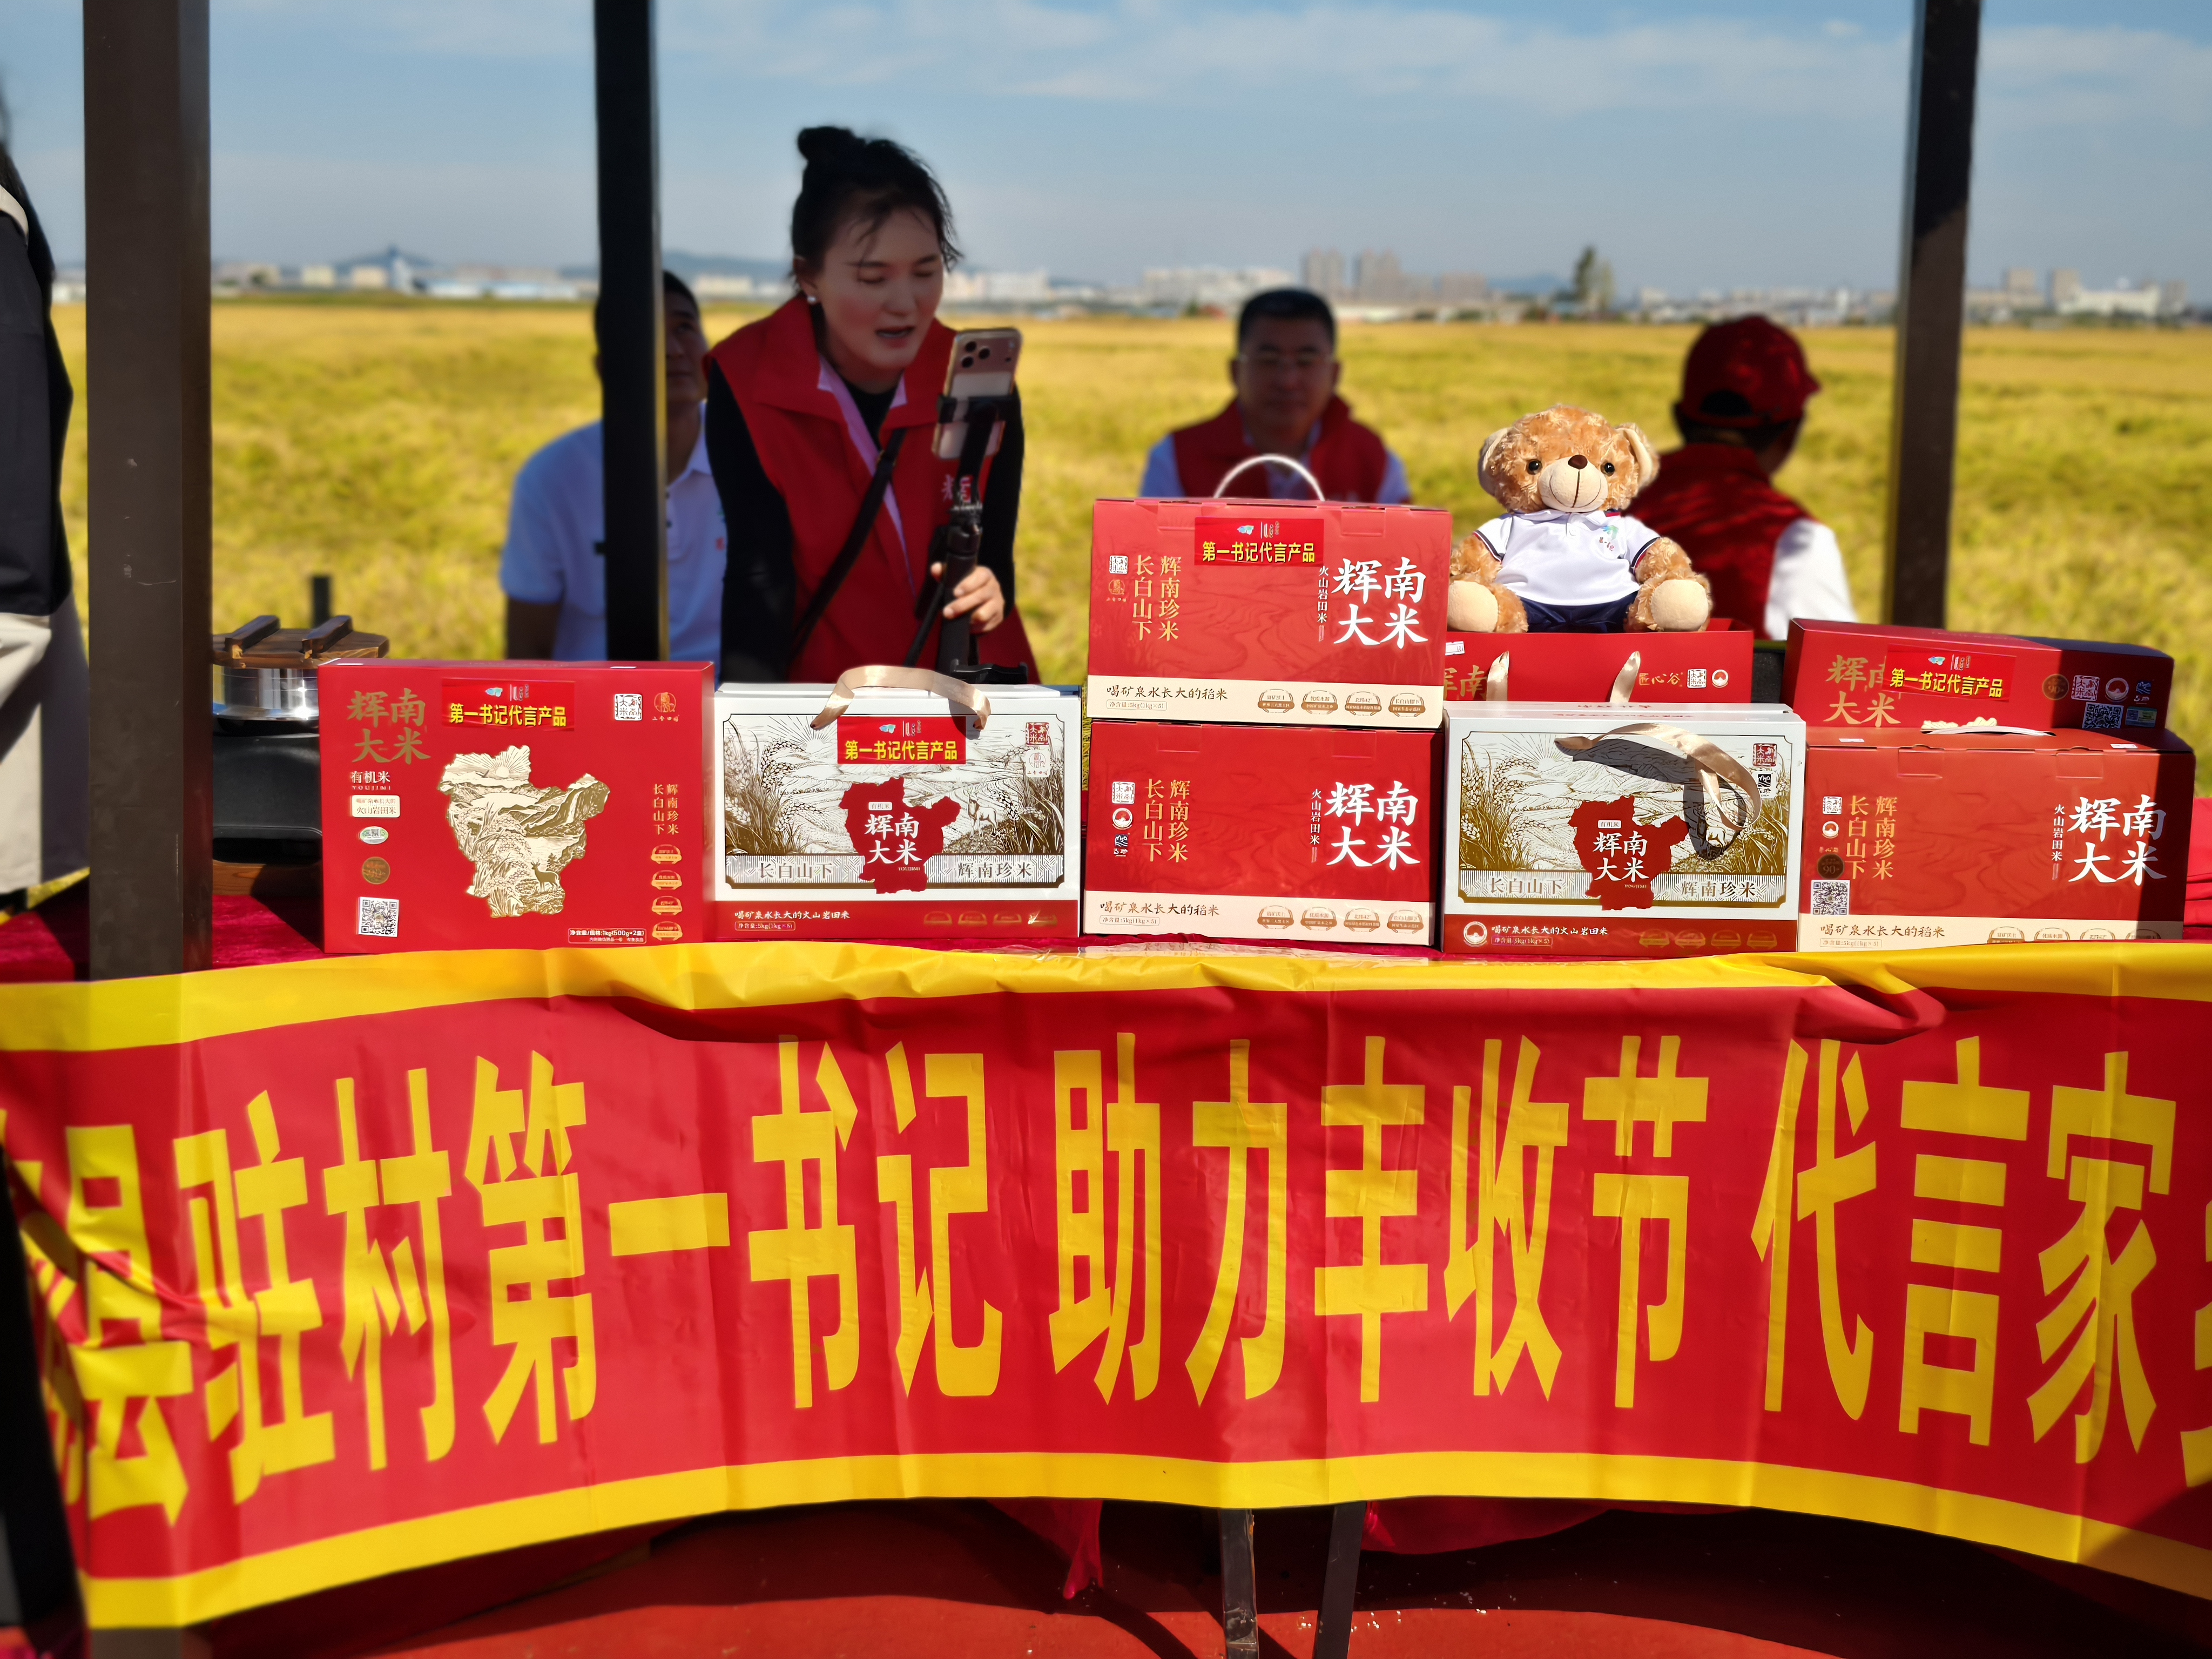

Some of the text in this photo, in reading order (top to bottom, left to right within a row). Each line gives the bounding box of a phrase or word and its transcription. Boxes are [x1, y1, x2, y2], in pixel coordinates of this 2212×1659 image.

[1203, 541, 1315, 563] 第一书记代言产品
[1132, 555, 1155, 641] 长白山下
[1158, 555, 1182, 642] 辉南珍米
[1317, 565, 1329, 624] 火山岩田米
[1331, 556, 1426, 604] 辉南
[1333, 603, 1428, 649] 大米
[1107, 685, 1228, 700] 喝矿泉水长大的稻米
[1890, 667, 2003, 698] 第一书记代言产品
[347, 687, 426, 729] 辉南
[449, 703, 567, 726] 第一书记代言产品
[1823, 691, 1901, 727] 大米
[352, 727, 431, 765] 大米
[845, 740, 957, 760] 第一书记代言产品
[351, 771, 390, 784] 有机米
[653, 784, 665, 835] 长白山下
[667, 784, 679, 835] 辉南珍米
[1142, 778, 1164, 862] 长白山下
[1167, 779, 1191, 863] 辉南珍米
[1310, 788, 1322, 845] 火山岩田米
[1324, 780, 1419, 826] 辉南
[2067, 794, 2167, 842] 辉南
[864, 812, 919, 840] 辉南
[1593, 830, 1648, 858] 辉南
[1845, 795, 1870, 880] 长白山下
[1872, 796, 1898, 880] 辉南珍米
[2051, 804, 2066, 862] 火山岩田米
[867, 839, 922, 865] 大米
[1326, 826, 1421, 871] 大米
[2068, 841, 2167, 886] 大米
[758, 862, 832, 879] 长白山下
[957, 862, 1032, 879] 辉南珍米
[1488, 878, 1562, 895] 长白山下
[1594, 857, 1649, 883] 大米
[1100, 901, 1220, 916] 喝矿泉水长大的稻米
[1681, 881, 1756, 898] 辉南珍米
[734, 910, 851, 920] 喝矿泉水长大的火山岩田米
[1491, 925, 1609, 935] 喝矿泉水长大的火山岩田米
[1820, 923, 1945, 938] 喝矿泉水长大的稻米
[1048, 1032, 1710, 1408] 助力丰收节
[1750, 1035, 2212, 1488] 代言家
